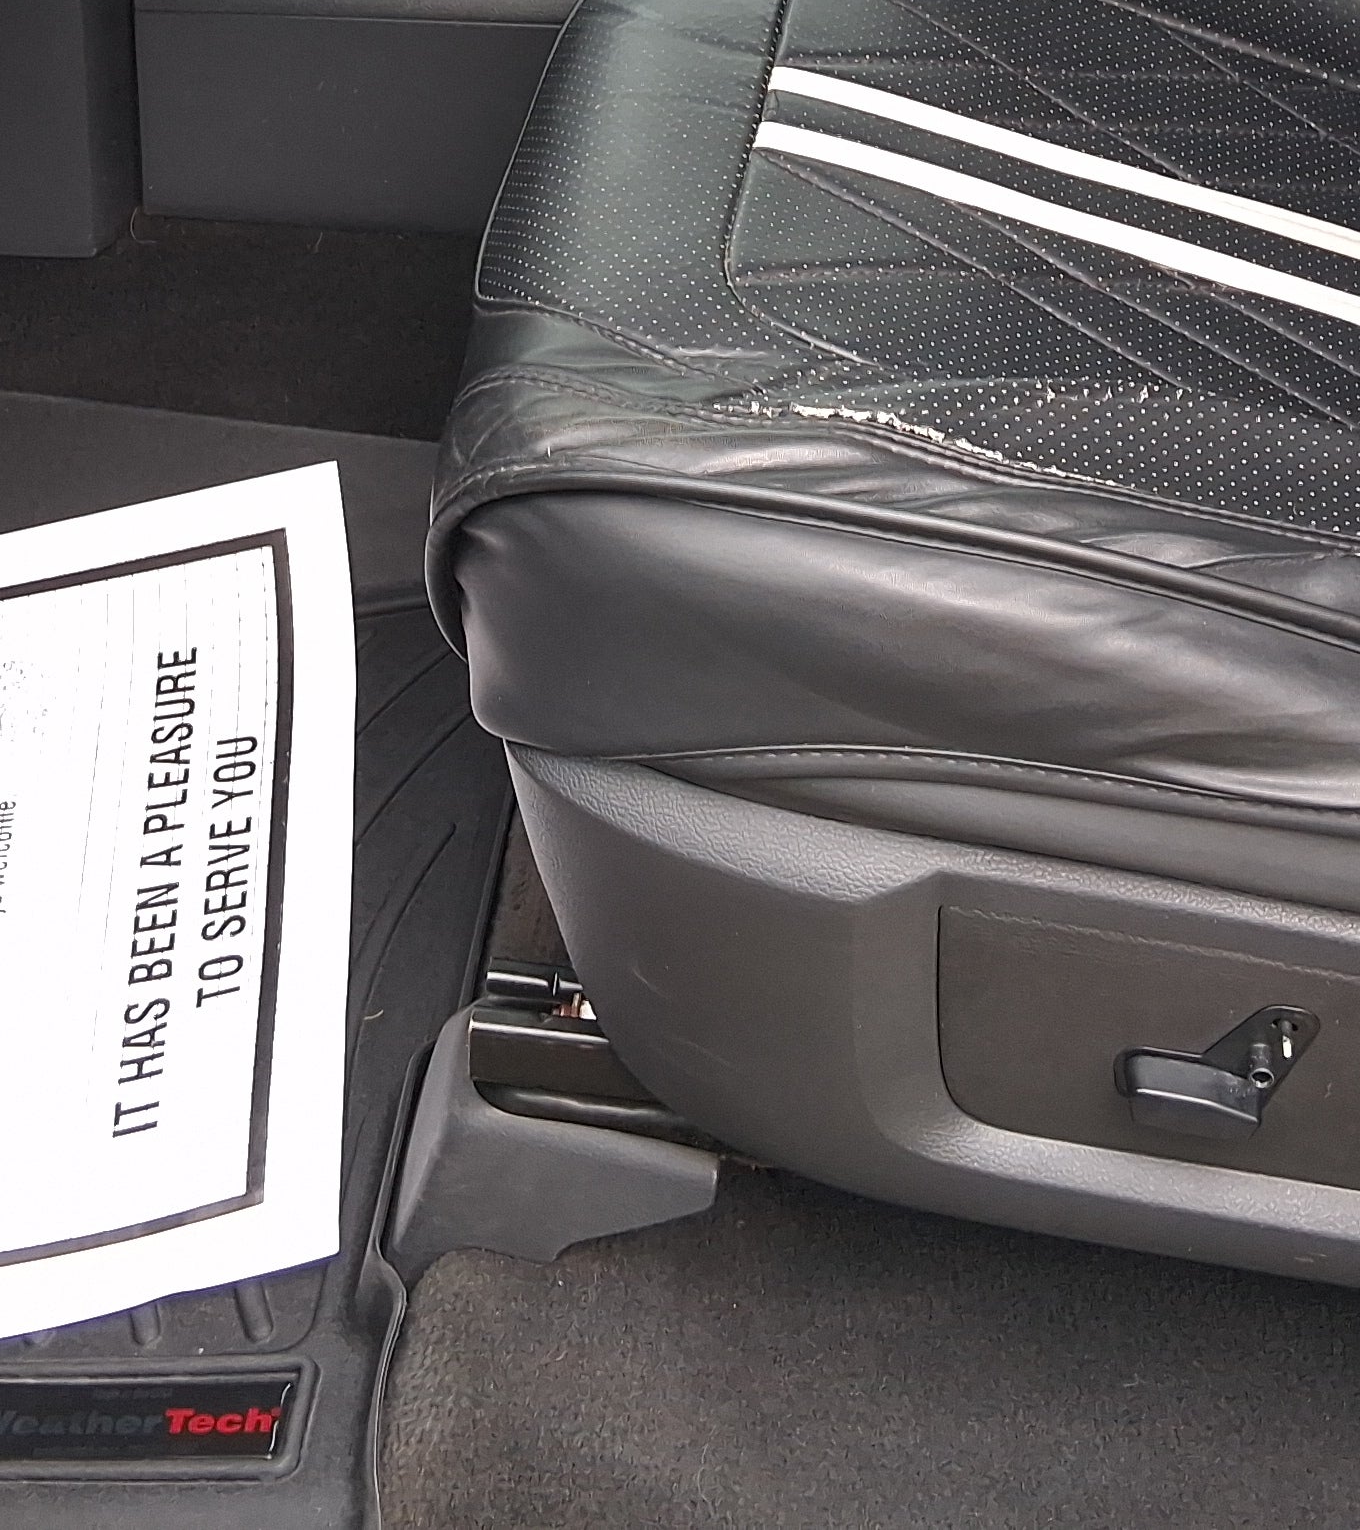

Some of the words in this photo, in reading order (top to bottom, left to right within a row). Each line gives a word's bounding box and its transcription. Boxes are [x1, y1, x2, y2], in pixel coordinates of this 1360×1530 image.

[143, 645, 198, 837] PLEASURE
[211, 735, 259, 808] YOU
[140, 843, 183, 868] A
[201, 816, 253, 942] SERVE
[128, 880, 179, 989] BEEN
[196, 953, 246, 1008] TO
[118, 999, 169, 1086] HAS
[112, 1100, 160, 1138] IT
